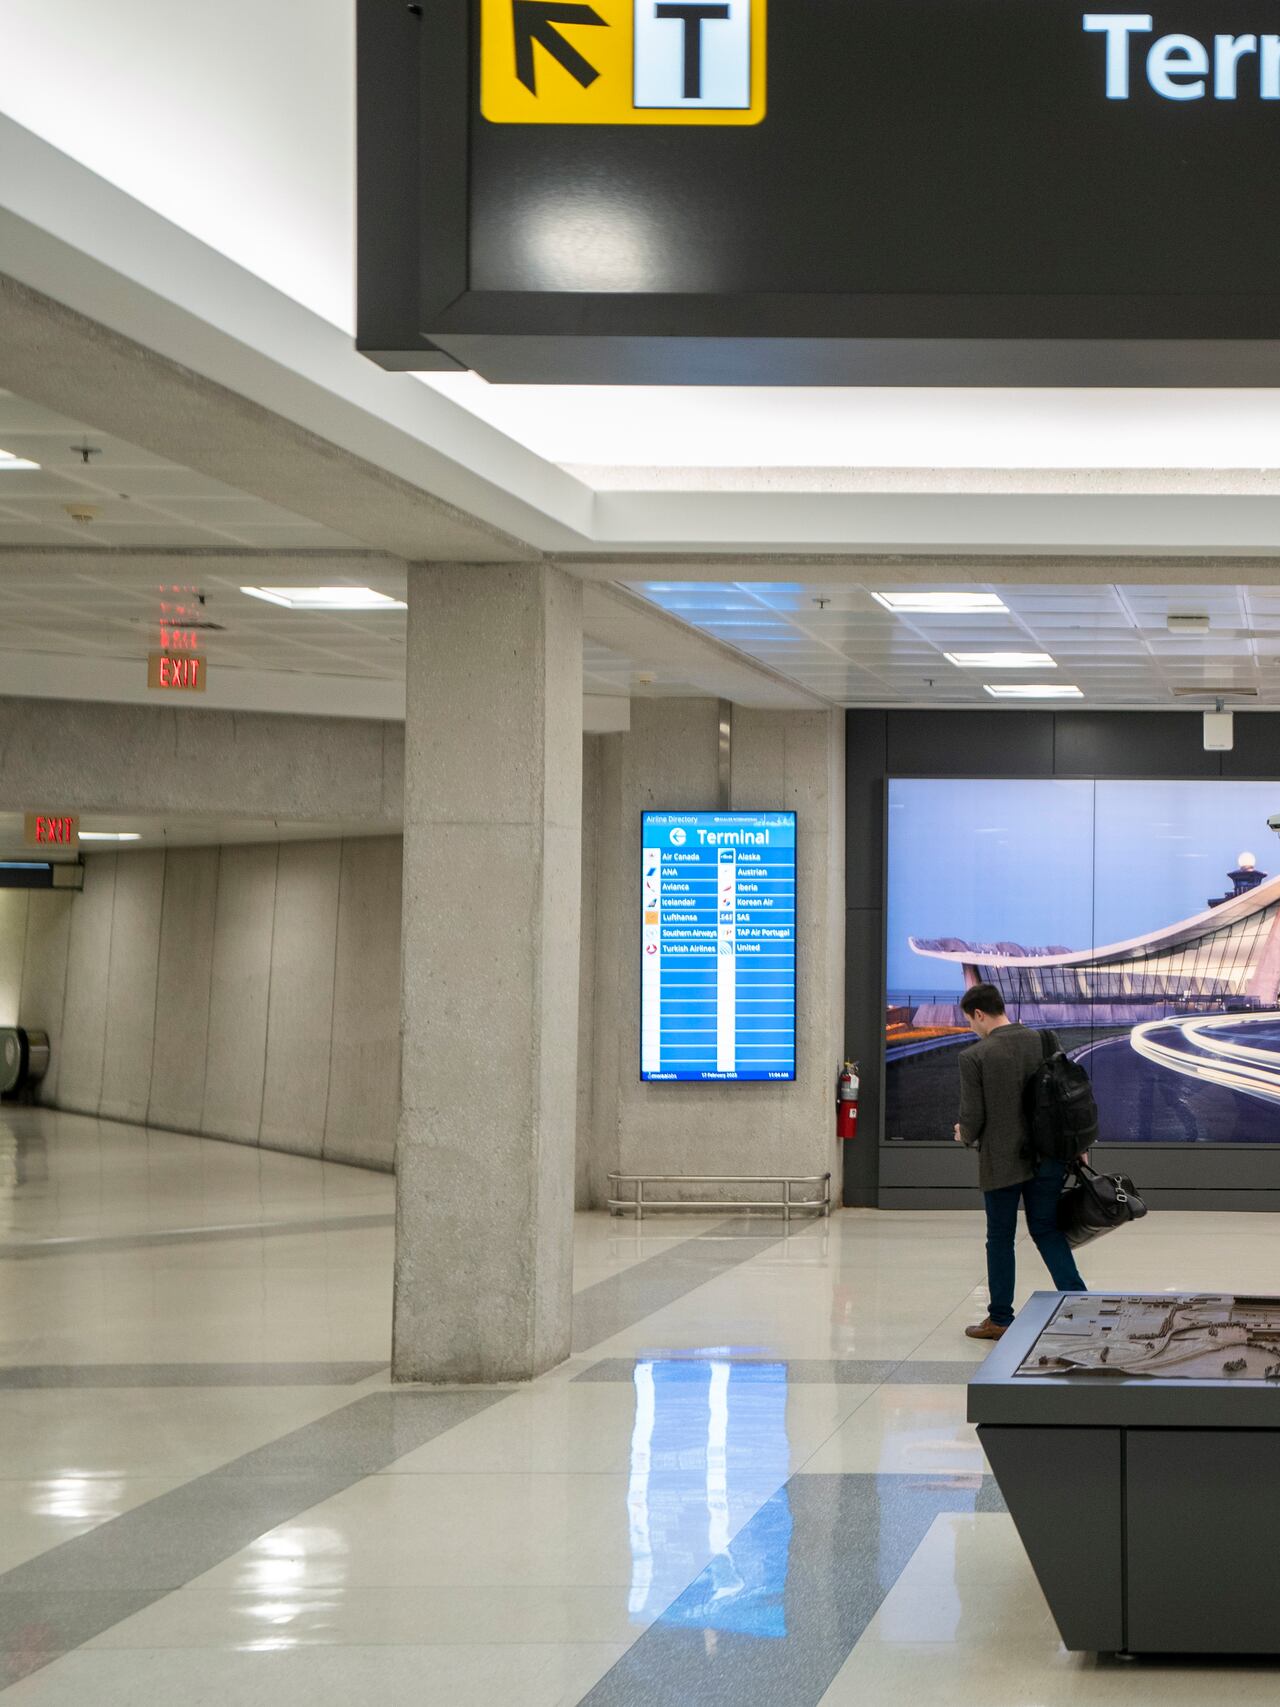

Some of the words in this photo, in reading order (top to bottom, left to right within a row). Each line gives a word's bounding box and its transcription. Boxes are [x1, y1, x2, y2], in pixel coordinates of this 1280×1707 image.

[654, 3, 730, 99] T
[159, 657, 200, 688] EXIT
[646, 815, 667, 823] Airline
[668, 815, 698, 824] Directory
[35, 816, 73, 844] EXIT
[697, 828, 769, 845] Terminal
[662, 853, 673, 861] Air
[674, 853, 700, 861] Canada
[738, 853, 761, 861] Alaska
[662, 868, 678, 876] ANA
[738, 868, 767, 877] Austrian
[662, 883, 689, 891] Avianca
[738, 883, 758, 891] Iberia
[662, 898, 696, 906] Icelandair
[737, 898, 762, 906] Korean
[763, 898, 773, 906] Air
[663, 913, 698, 921] Lufthansa
[737, 913, 750, 921] SAS
[663, 929, 692, 937] Southern
[692, 929, 717, 938] Airways
[737, 929, 750, 937] TAP
[751, 929, 761, 937] Air
[762, 929, 790, 938] Portugal
[663, 945, 687, 953] Turkish
[688, 945, 716, 953] Airlines
[737, 944, 760, 952] United
